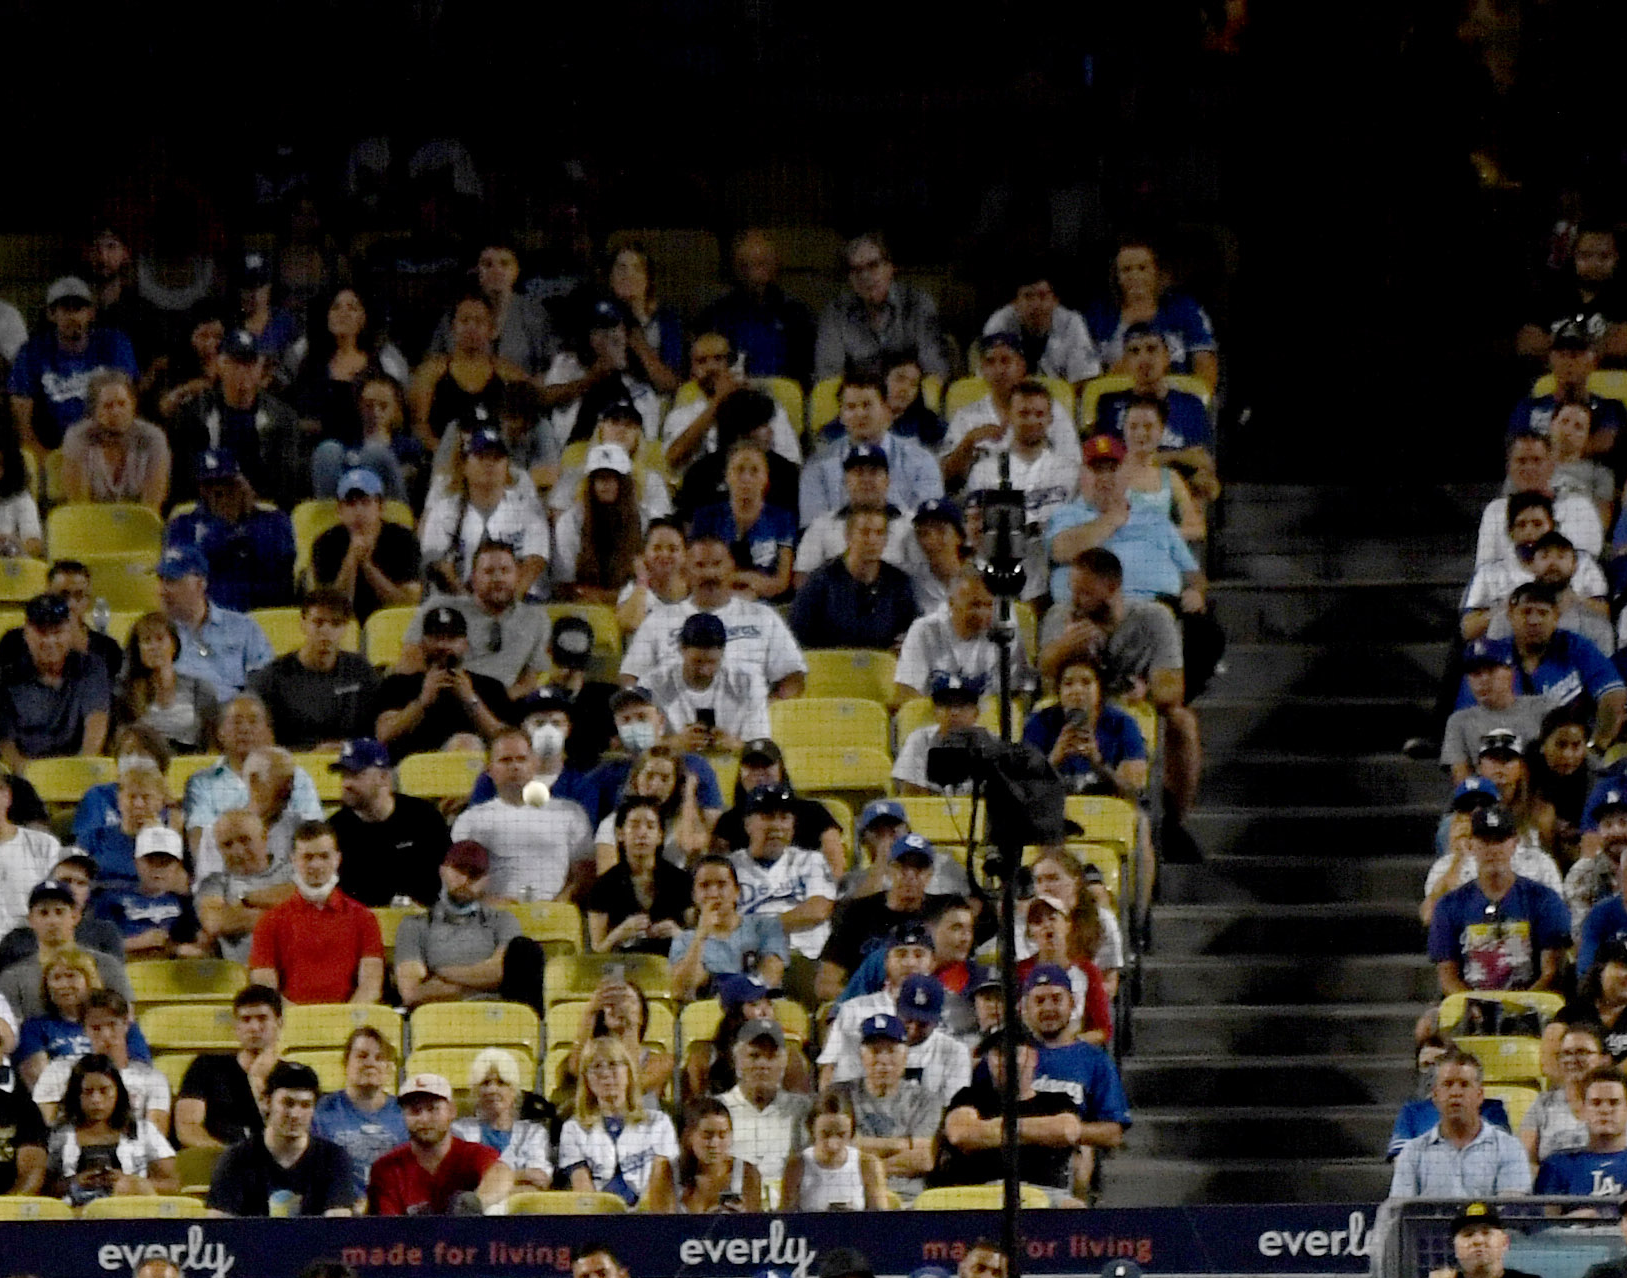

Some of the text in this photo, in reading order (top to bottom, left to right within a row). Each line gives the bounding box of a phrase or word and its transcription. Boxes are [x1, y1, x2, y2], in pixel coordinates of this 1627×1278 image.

[1592, 1170, 1622, 1195] LA
[680, 1219, 815, 1278] everly
[1072, 1234, 1152, 1263] living
[1258, 1211, 1375, 1256] everl
[341, 1240, 572, 1270] made for living
